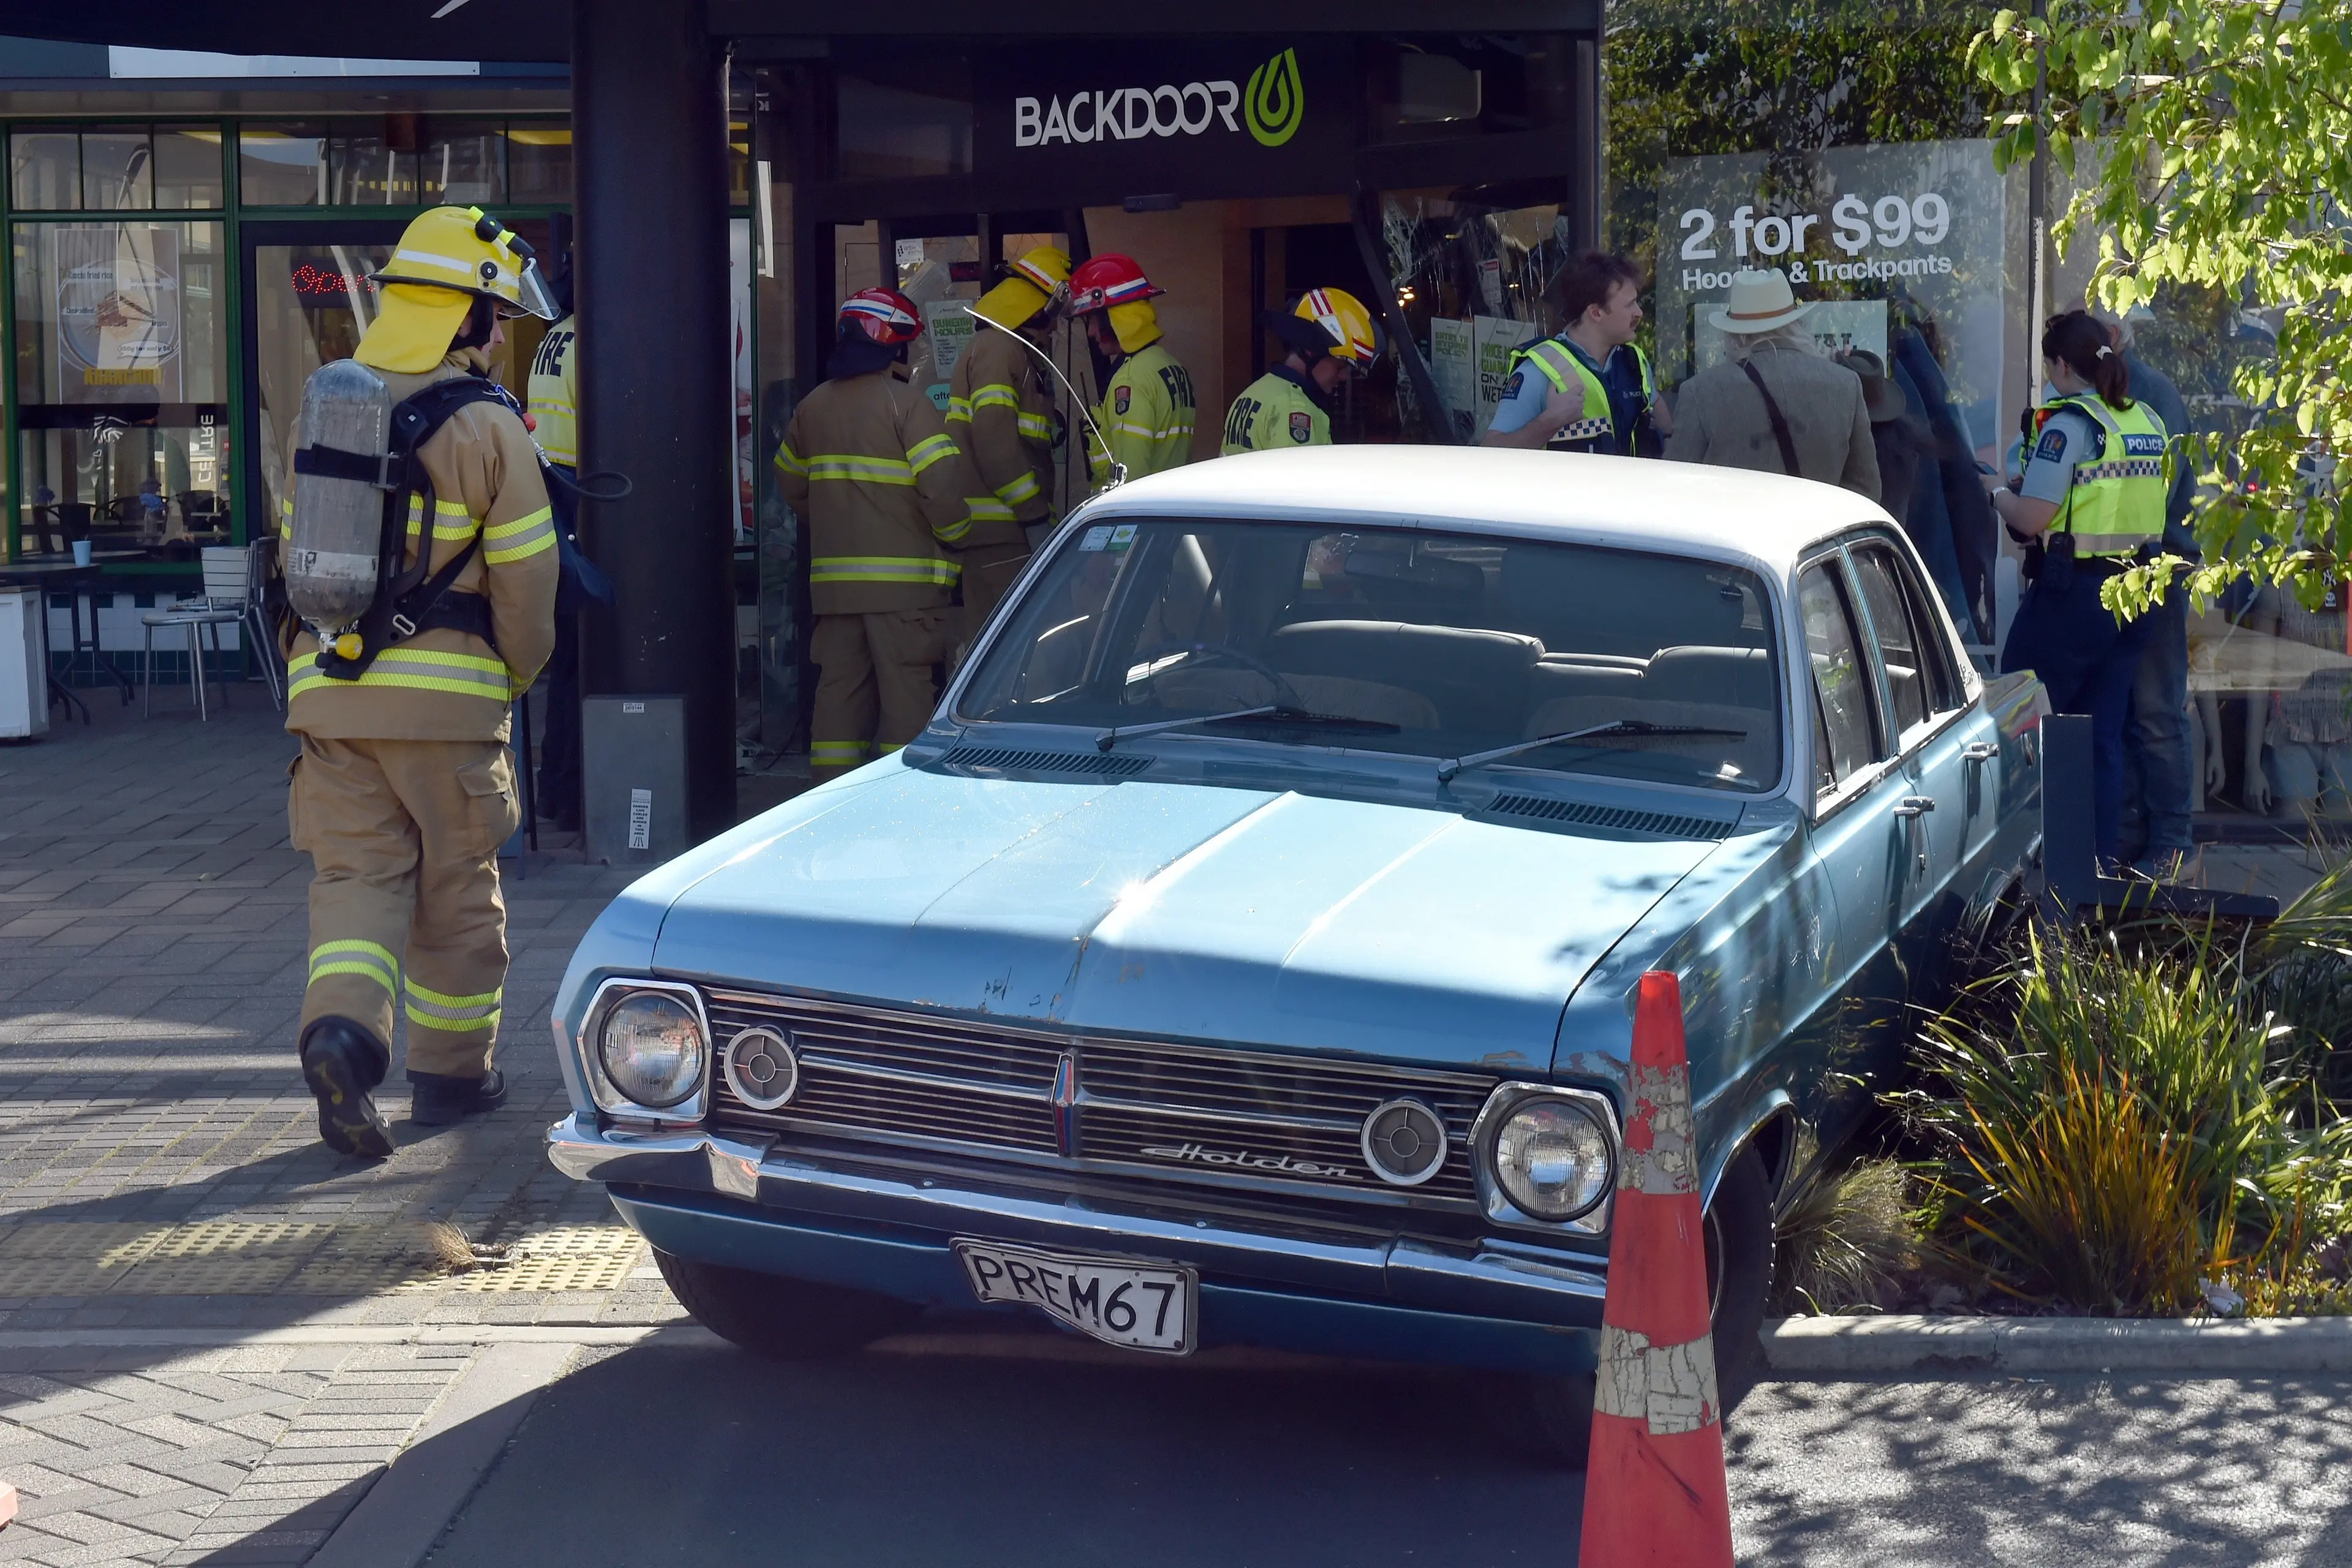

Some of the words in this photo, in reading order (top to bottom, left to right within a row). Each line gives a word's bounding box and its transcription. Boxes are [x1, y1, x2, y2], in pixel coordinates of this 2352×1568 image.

[1016, 80, 1240, 146] BACKDOOR
[1680, 208, 1716, 261] 2
[1729, 205, 1819, 257] for
[1831, 192, 1951, 257] $99
[1789, 260, 1809, 284] &
[1812, 252, 1953, 282] Trackpants
[933, 316, 973, 328] DUNEDIN
[935, 326, 974, 337] HOURS
[1481, 373, 1498, 386] ON
[1226, 397, 1262, 450] FIRE
[2127, 437, 2164, 451] POLICE
[1139, 1142, 1364, 1180] Holden
[970, 1254, 1177, 1336] PREM67
